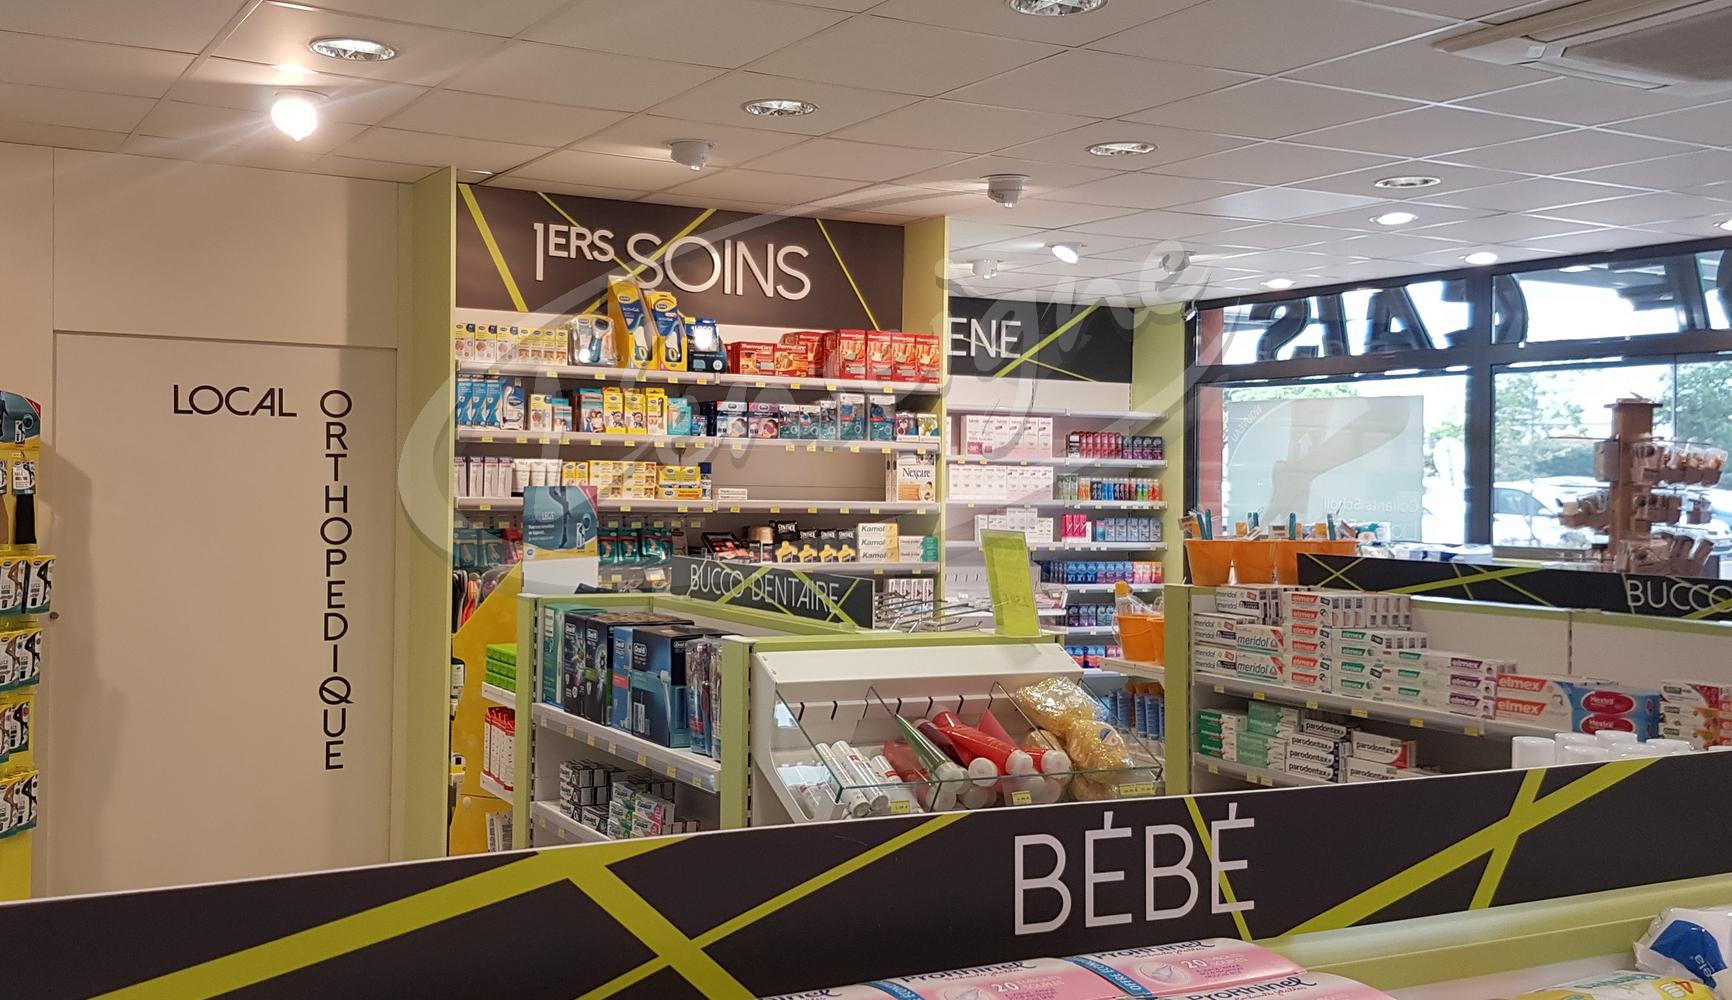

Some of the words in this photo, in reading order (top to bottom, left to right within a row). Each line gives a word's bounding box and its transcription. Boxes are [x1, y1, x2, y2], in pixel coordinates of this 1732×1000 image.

[626, 232, 812, 301] SOINS
[947, 317, 1022, 359] ENE
[172, 384, 298, 418] LOCAL
[902, 467, 931, 479] Nexcare
[860, 525, 886, 533] Kamol
[860, 538, 887, 546] Kamol
[862, 551, 887, 559] Kamol
[318, 389, 355, 771] ORTHOPEDIQUE
[690, 564, 745, 598] BUCCO
[751, 573, 840, 613] DENTAIRE
[1627, 579, 1732, 613] BUCCO
[1237, 635, 1269, 648] meridol
[1237, 661, 1269, 675] meridol
[1497, 676, 1541, 691] elmex
[1496, 700, 1540, 716] elmex
[1304, 721, 1342, 735] parodontax
[1291, 736, 1329, 750] parodontax
[1355, 740, 1394, 755] parodontax
[1289, 749, 1329, 764] parodontax
[1288, 763, 1328, 776] parodontax
[1014, 802, 1255, 936] BÉBÉ
[1181, 959, 1208, 969] 20
[991, 982, 1020, 993] 20
[1185, 976, 1318, 1000] ProRhinel
